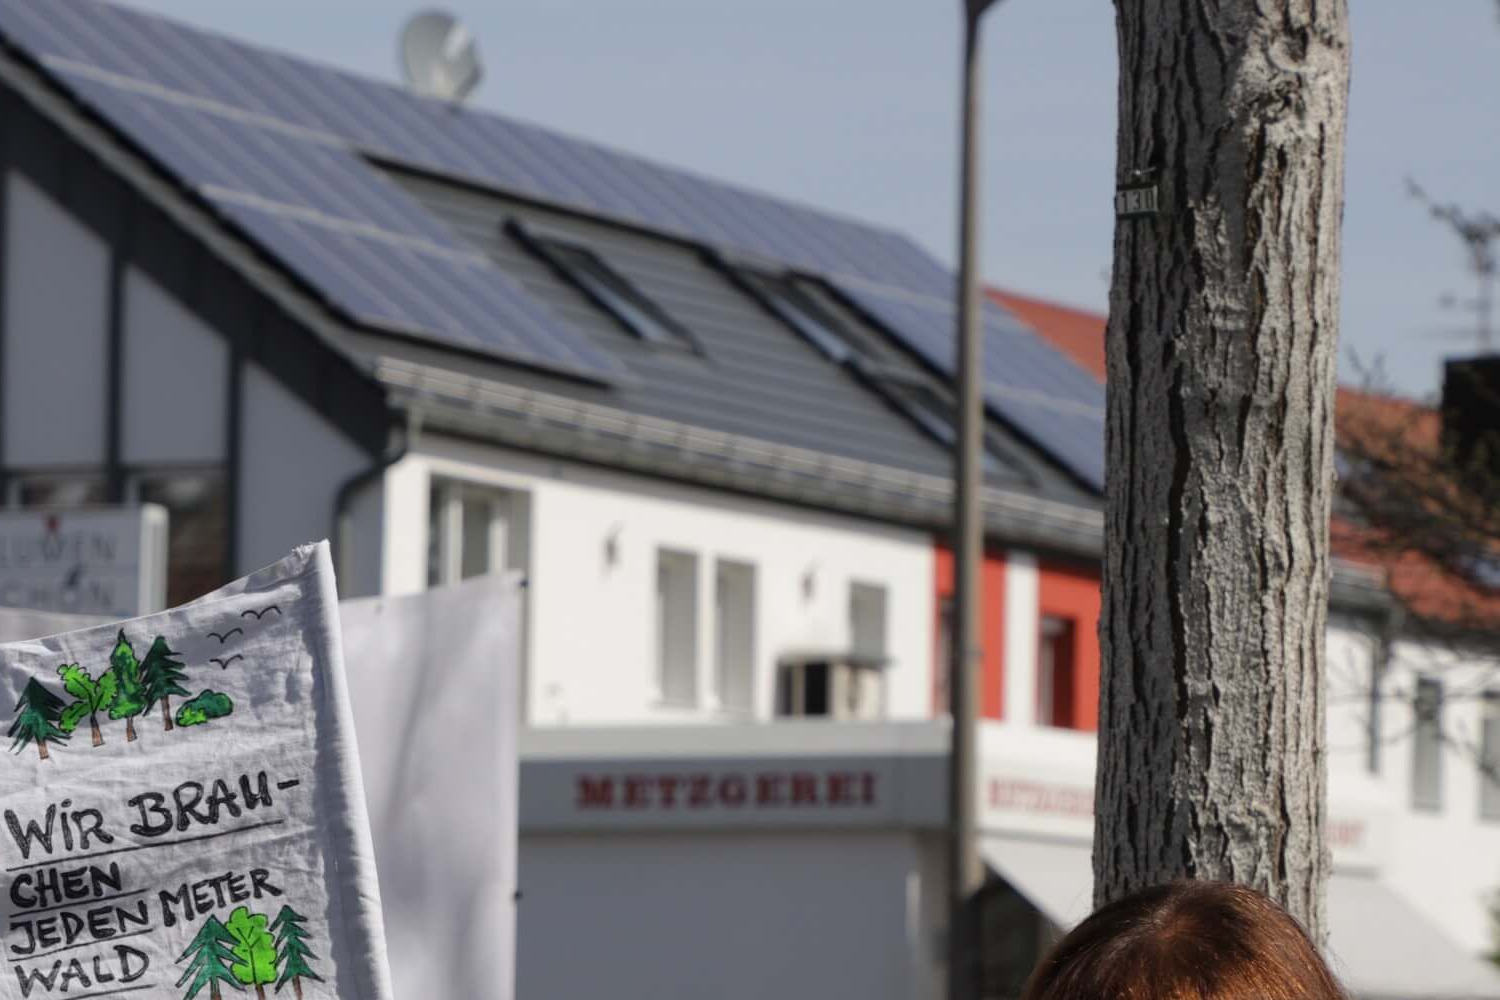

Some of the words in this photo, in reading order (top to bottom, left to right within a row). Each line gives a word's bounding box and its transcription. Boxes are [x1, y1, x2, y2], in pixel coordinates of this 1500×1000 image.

[574, 769, 880, 811] METZGEREI
[8, 861, 123, 909] CHEN
[9, 899, 151, 956] JEDEN
[157, 868, 283, 928] METER
[13, 943, 151, 999] WALD
